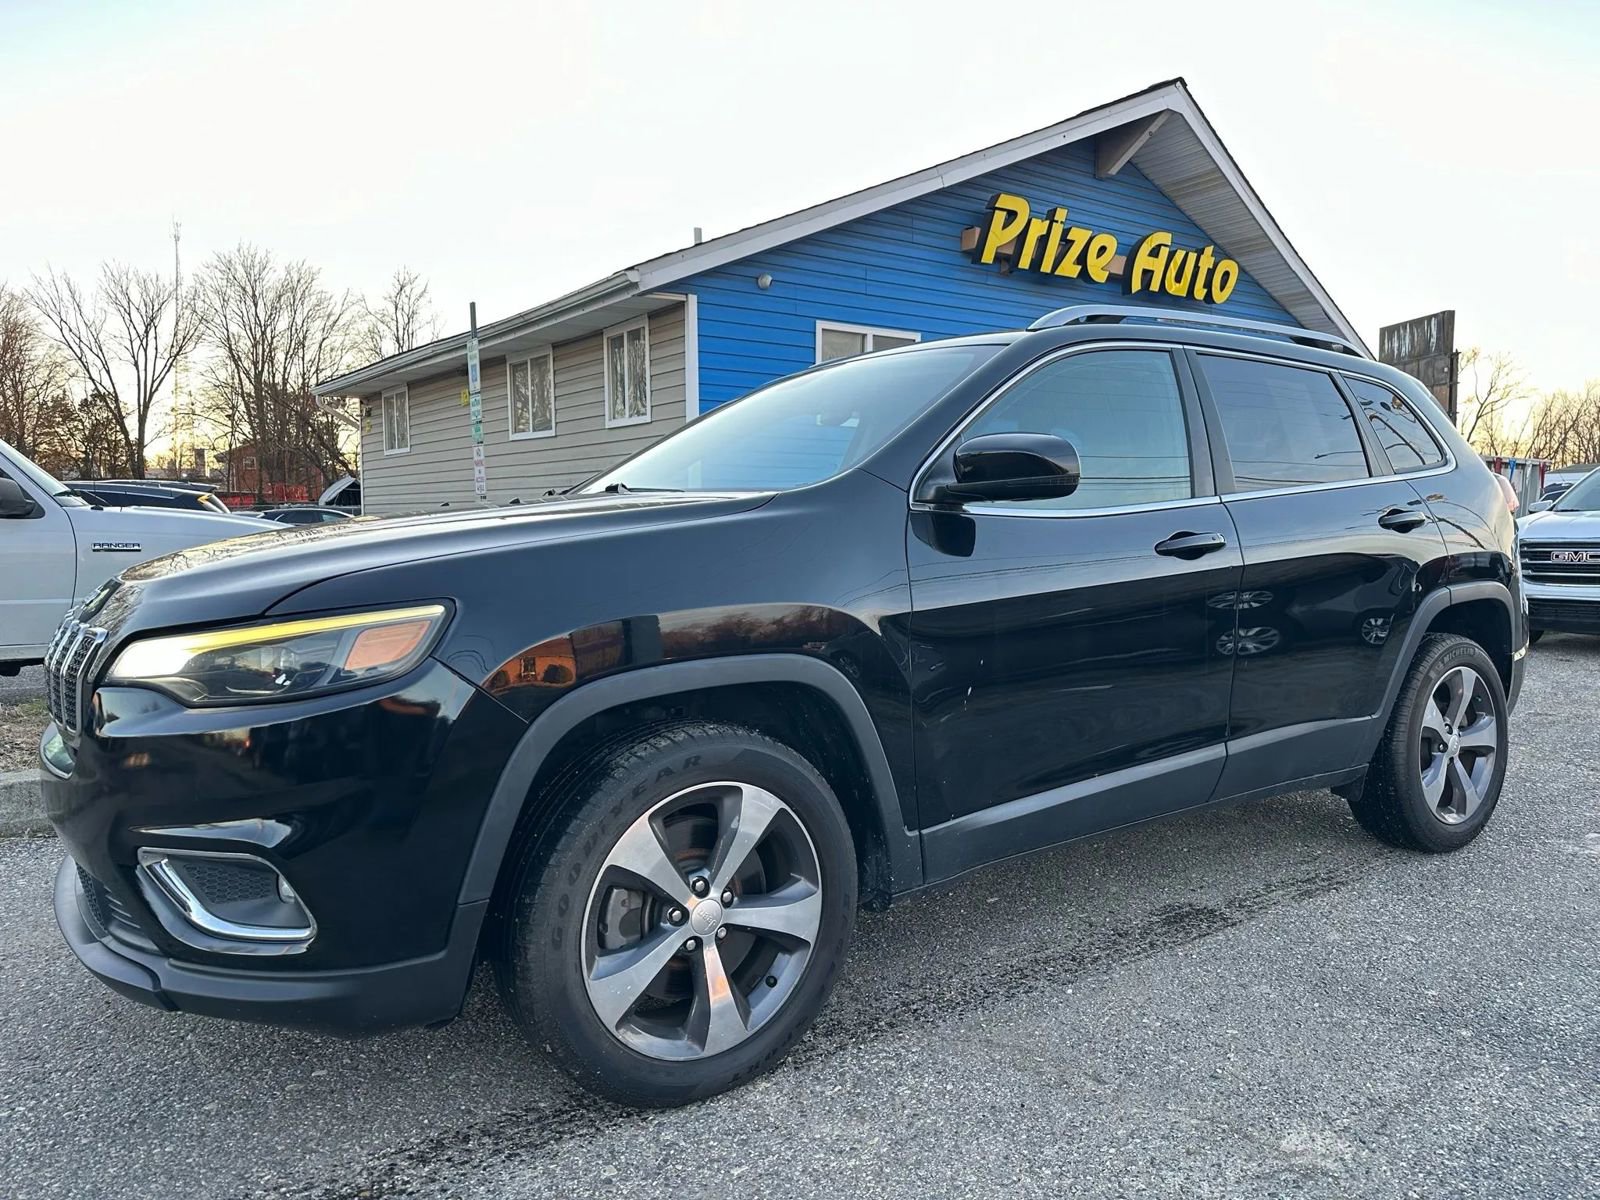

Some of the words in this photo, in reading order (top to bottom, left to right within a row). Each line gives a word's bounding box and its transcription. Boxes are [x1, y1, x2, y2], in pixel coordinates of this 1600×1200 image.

[979, 192, 1118, 284] Prize
[1130, 231, 1240, 305] Auto
[1551, 551, 1600, 563] GMC
[1442, 646, 1476, 665] MICHELIN
